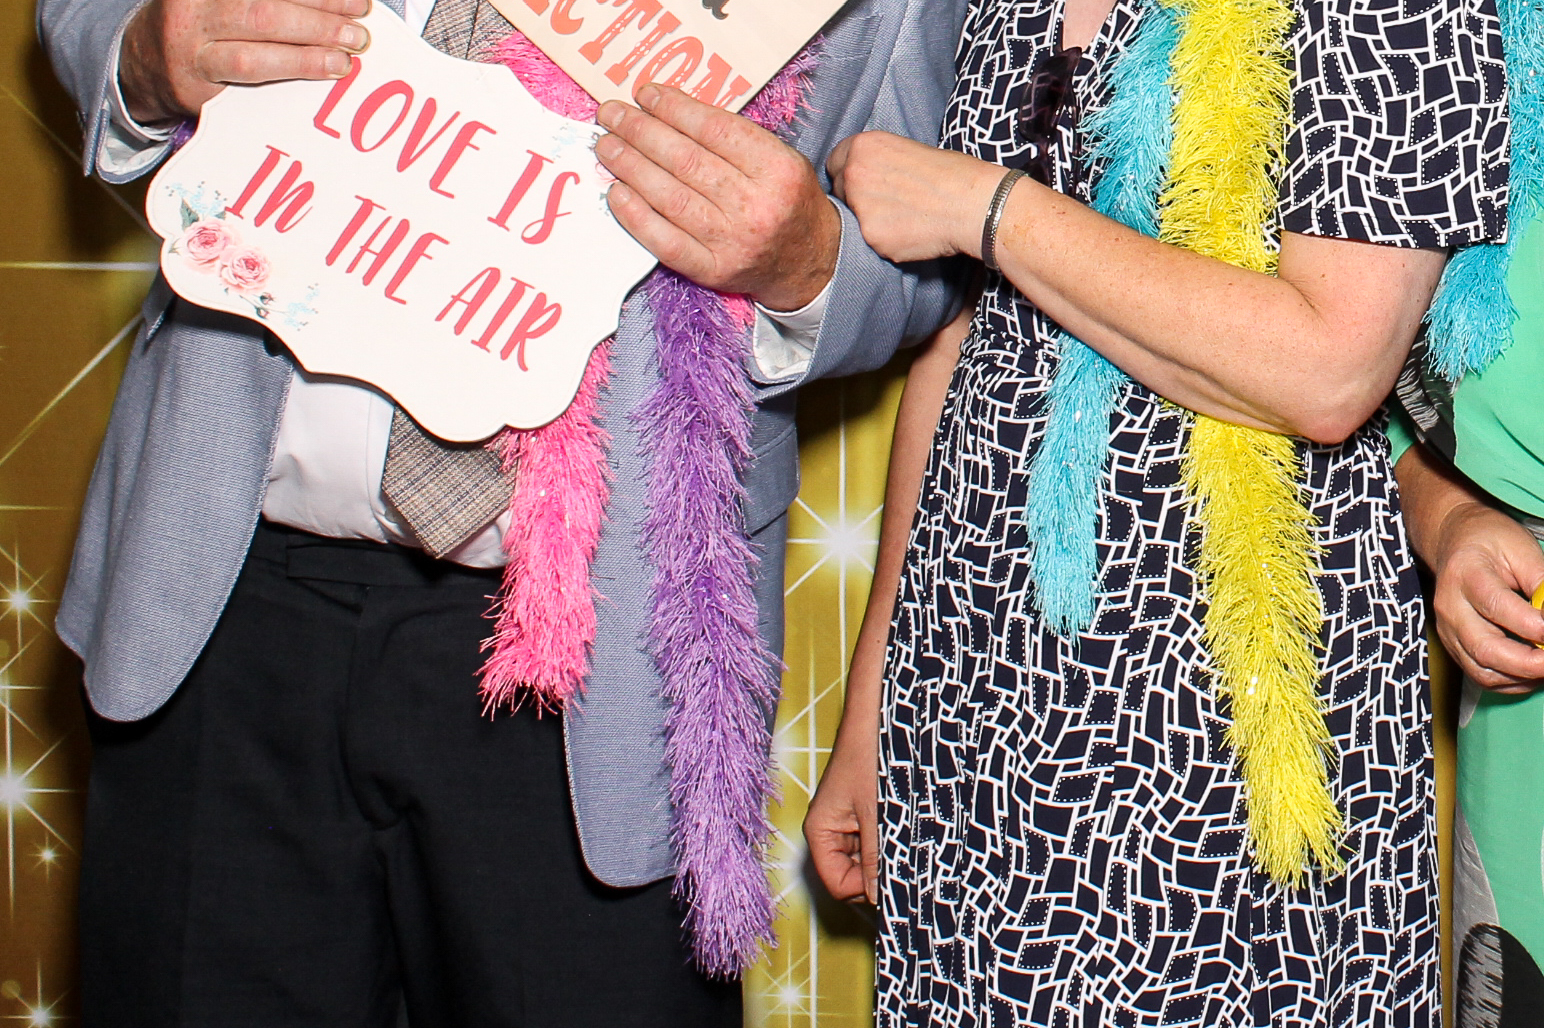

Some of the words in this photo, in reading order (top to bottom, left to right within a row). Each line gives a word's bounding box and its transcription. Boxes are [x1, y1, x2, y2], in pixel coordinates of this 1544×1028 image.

[313, 55, 497, 200] LOVE
[487, 149, 581, 245] IS
[325, 195, 451, 306] THE
[434, 266, 563, 372] AIR
